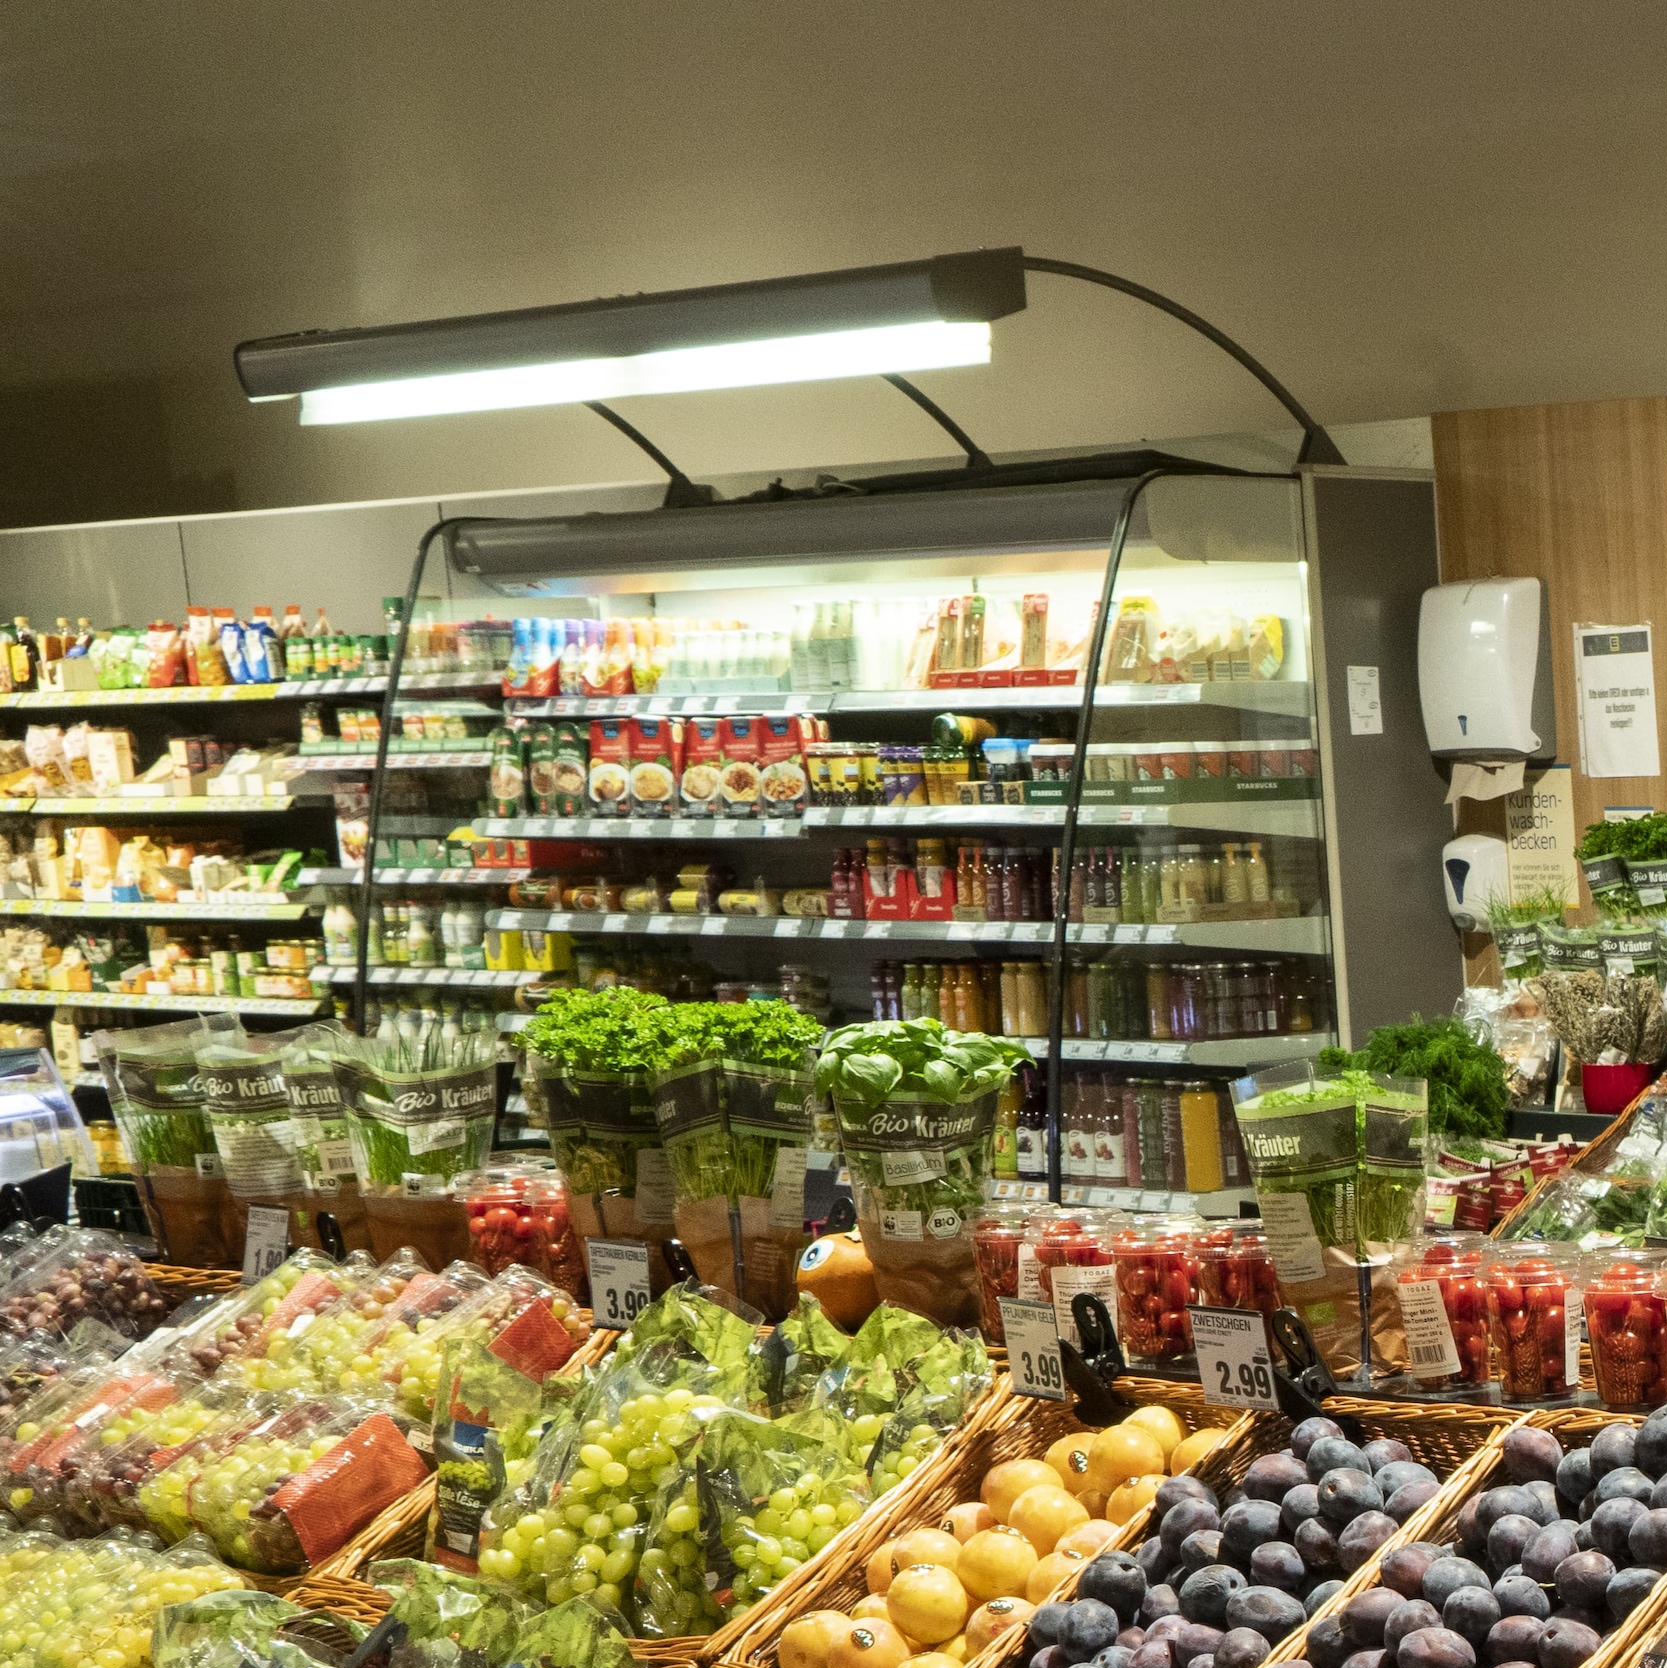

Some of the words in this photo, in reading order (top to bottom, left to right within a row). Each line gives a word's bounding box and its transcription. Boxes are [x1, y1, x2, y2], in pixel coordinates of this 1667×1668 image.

[1082, 789, 1115, 797] STARBUCKS
[1131, 785, 1165, 794] STARBUCKS
[1236, 781, 1279, 790] STARBUCKS
[1508, 792, 1562, 809] Kunden-
[1509, 811, 1554, 829] wasch-
[1511, 832, 1557, 850] becken
[1619, 938, 1653, 954] Kräuter
[206, 1074, 232, 1097] Bio
[397, 1088, 438, 1113] Bio
[440, 1082, 495, 1107] Kräuter
[870, 1113, 908, 1136] Bio
[914, 1112, 976, 1139] Kräuter
[1249, 1131, 1301, 1160] Kräuter
[884, 1154, 944, 1177] Basilikum
[933, 1215, 957, 1230] BIO
[1001, 1304, 1037, 1323] PFLAUMEN
[1037, 1309, 1056, 1325] GELB
[1192, 1313, 1252, 1333] ZWETSCHGEN
[1021, 1350, 1062, 1390] 3.99
[1215, 1360, 1273, 1400] 2.99
